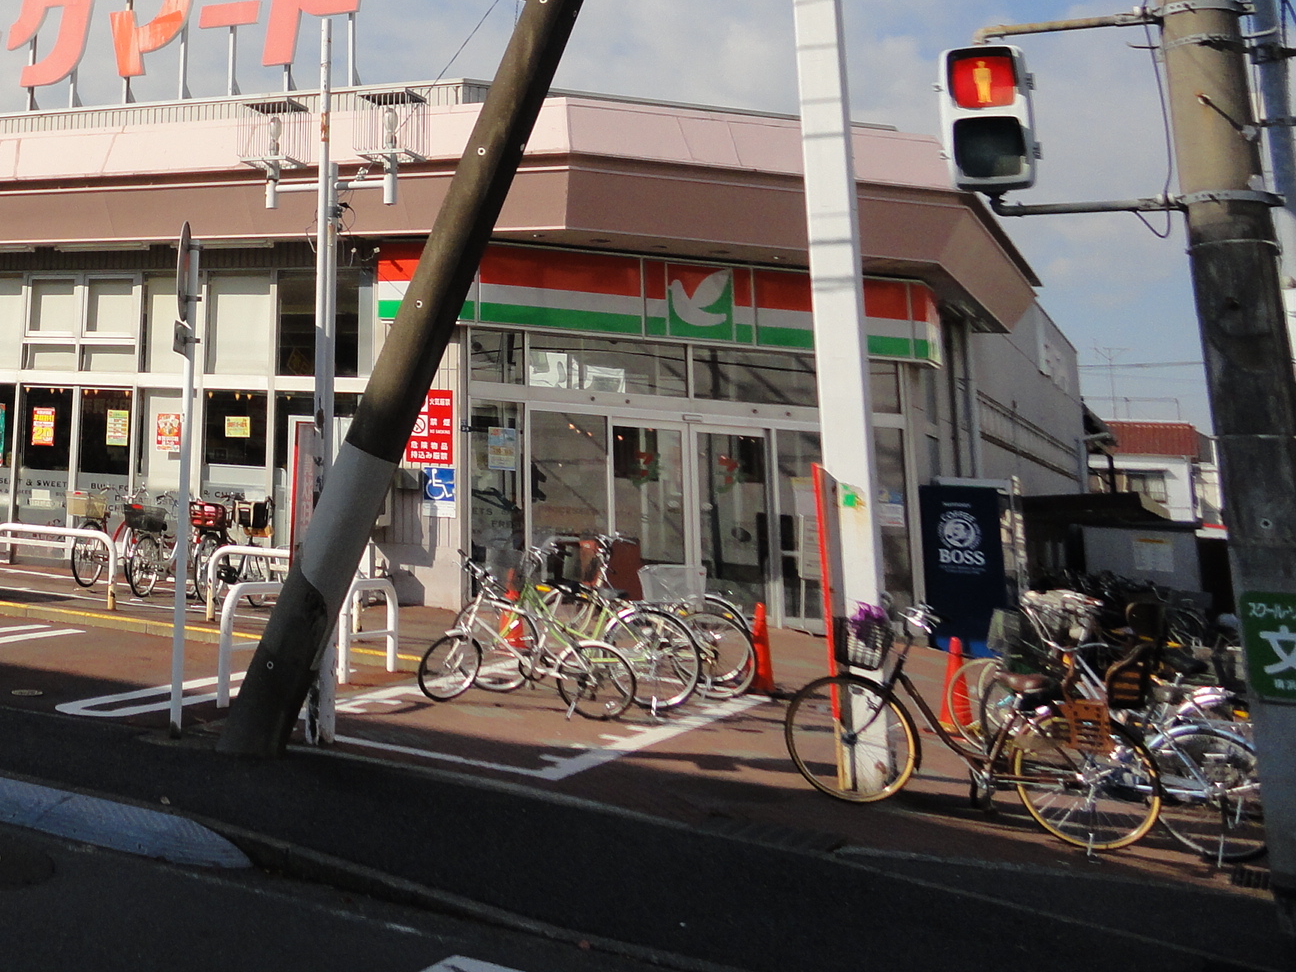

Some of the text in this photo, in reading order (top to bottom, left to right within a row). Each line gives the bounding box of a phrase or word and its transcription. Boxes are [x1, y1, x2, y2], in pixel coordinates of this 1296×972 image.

[429, 398, 451, 406] 火気厳禁
[430, 418, 451, 427] 禁煙
[410, 441, 448, 450] 危険物品
[410, 451, 448, 460] 持込み厳禁
[938, 548, 986, 566] BOSS
